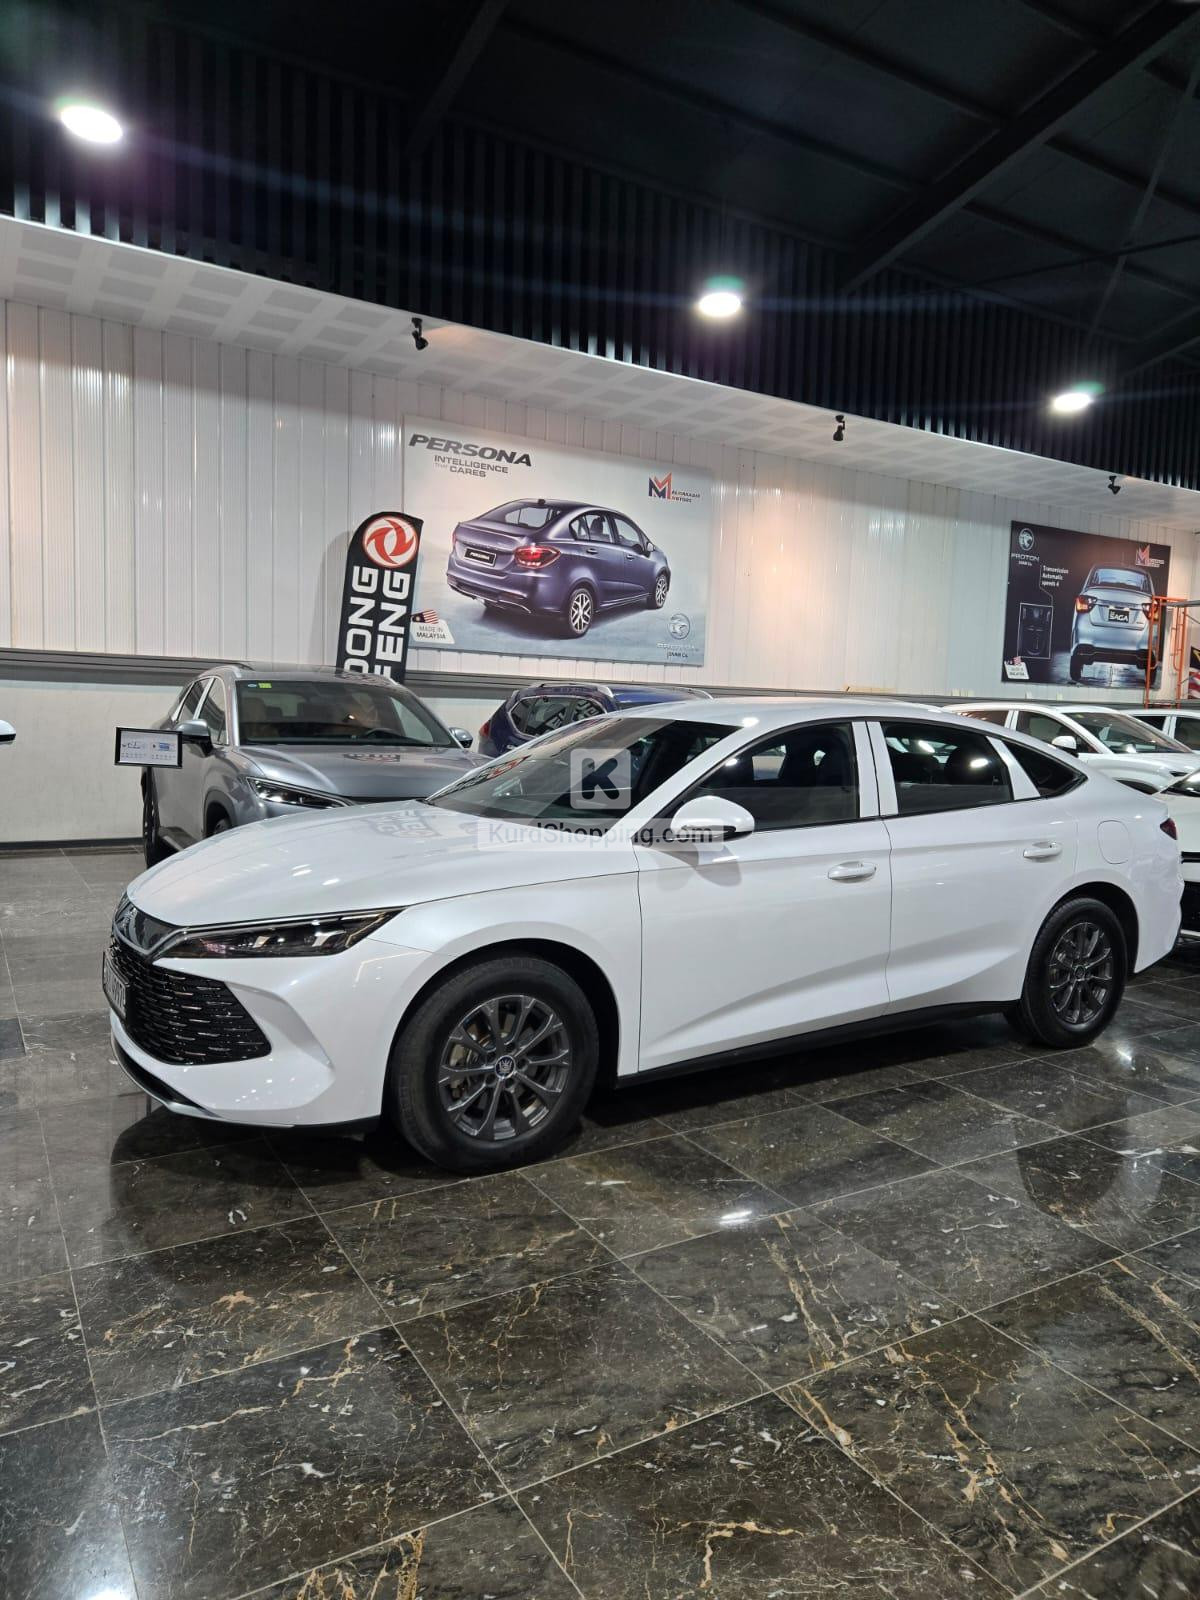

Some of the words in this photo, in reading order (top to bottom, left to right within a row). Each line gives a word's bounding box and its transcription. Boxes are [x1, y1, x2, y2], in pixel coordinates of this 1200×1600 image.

[408, 433, 532, 467] PERSONA
[434, 455, 508, 474] INTELLIGENCE
[449, 465, 487, 478] CARES
[1011, 553, 1040, 562] PROTON
[416, 631, 446, 639] MALAYSIA
